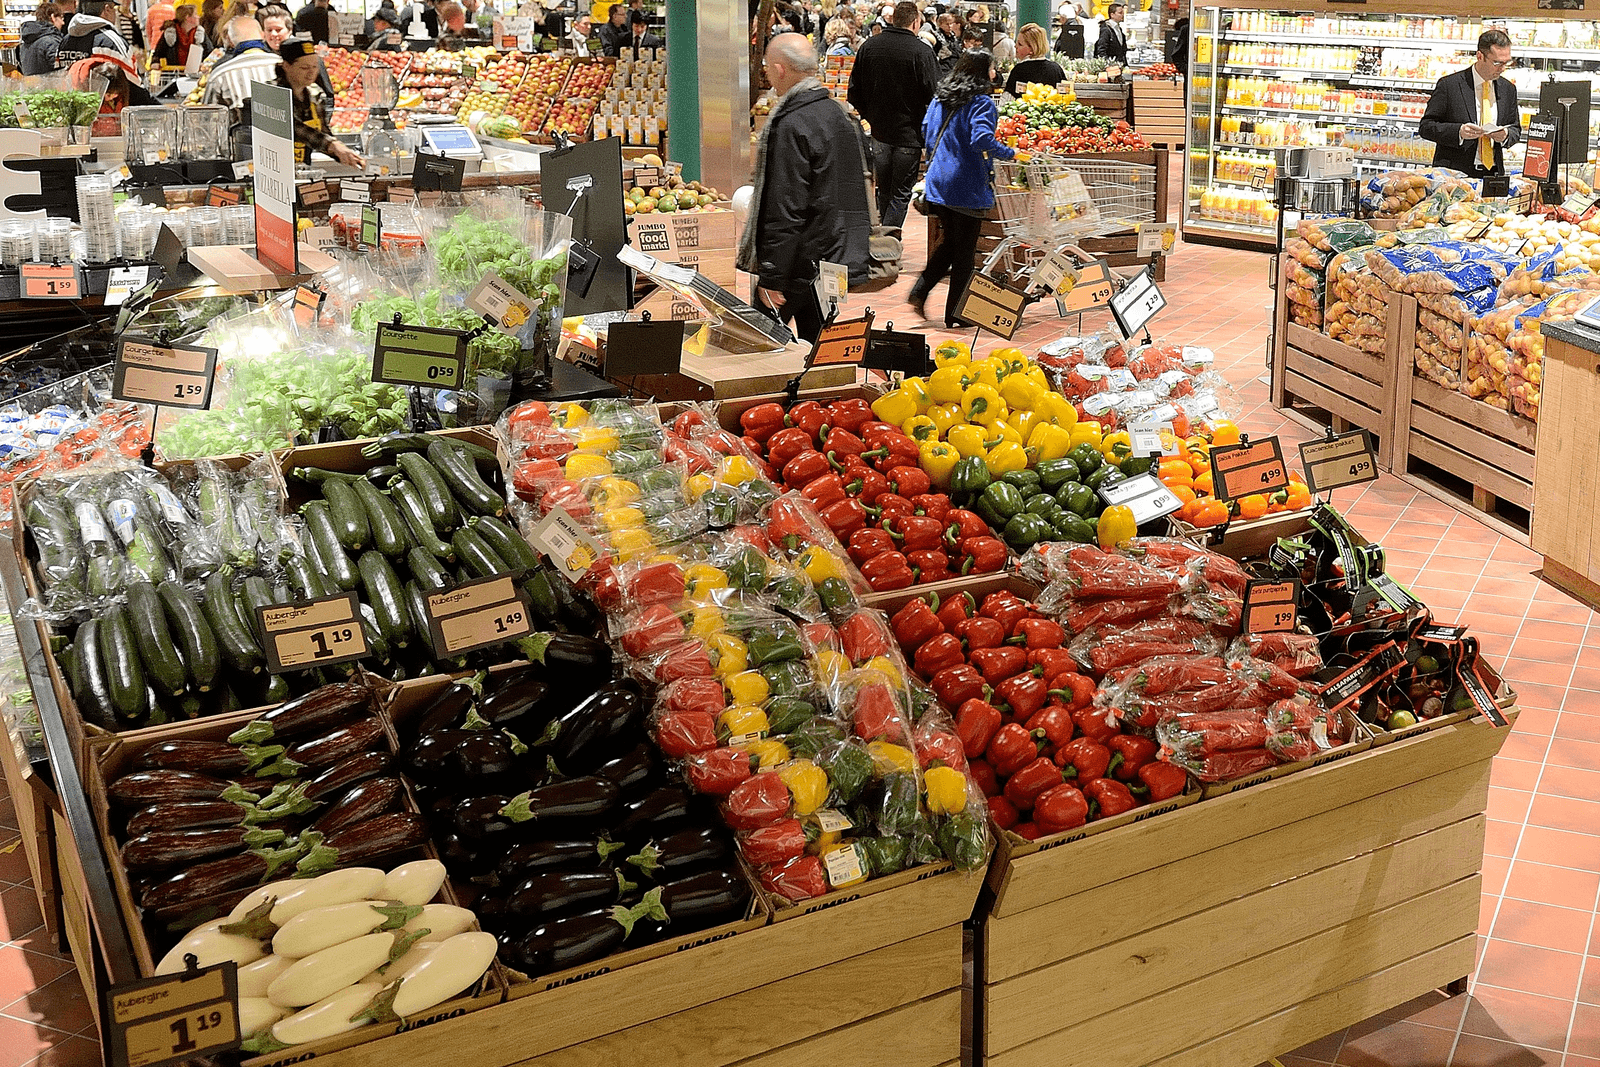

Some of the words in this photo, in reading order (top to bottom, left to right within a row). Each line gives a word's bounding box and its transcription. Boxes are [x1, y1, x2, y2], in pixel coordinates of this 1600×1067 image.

[637, 223, 666, 231] JUMBO
[675, 226, 699, 238] ood
[639, 231, 666, 243] food
[642, 242, 669, 251] markt
[489, 280, 501, 292] Scan
[500, 288, 511, 298] hier
[382, 331, 418, 340] Courgette
[124, 345, 164, 356] Courgette
[578, 351, 598, 365] JUM
[1335, 439, 1355, 450] pakket
[556, 516, 568, 529] Scan
[566, 526, 578, 538] hier
[431, 592, 470, 606] Aubergine
[266, 609, 307, 621] Aubergine
[1231, 774, 1273, 792] JUMBO
[1133, 803, 1178, 822] JUMBO
[1038, 832, 1087, 851] JUMBO
[917, 865, 956, 881] JUMB
[805, 894, 860, 915] JUMBO
[677, 930, 738, 951] JUMBO
[546, 967, 611, 991] JUMBO
[117, 990, 169, 1008] Aubergine
[394, 1008, 466, 1034] JUMBO
